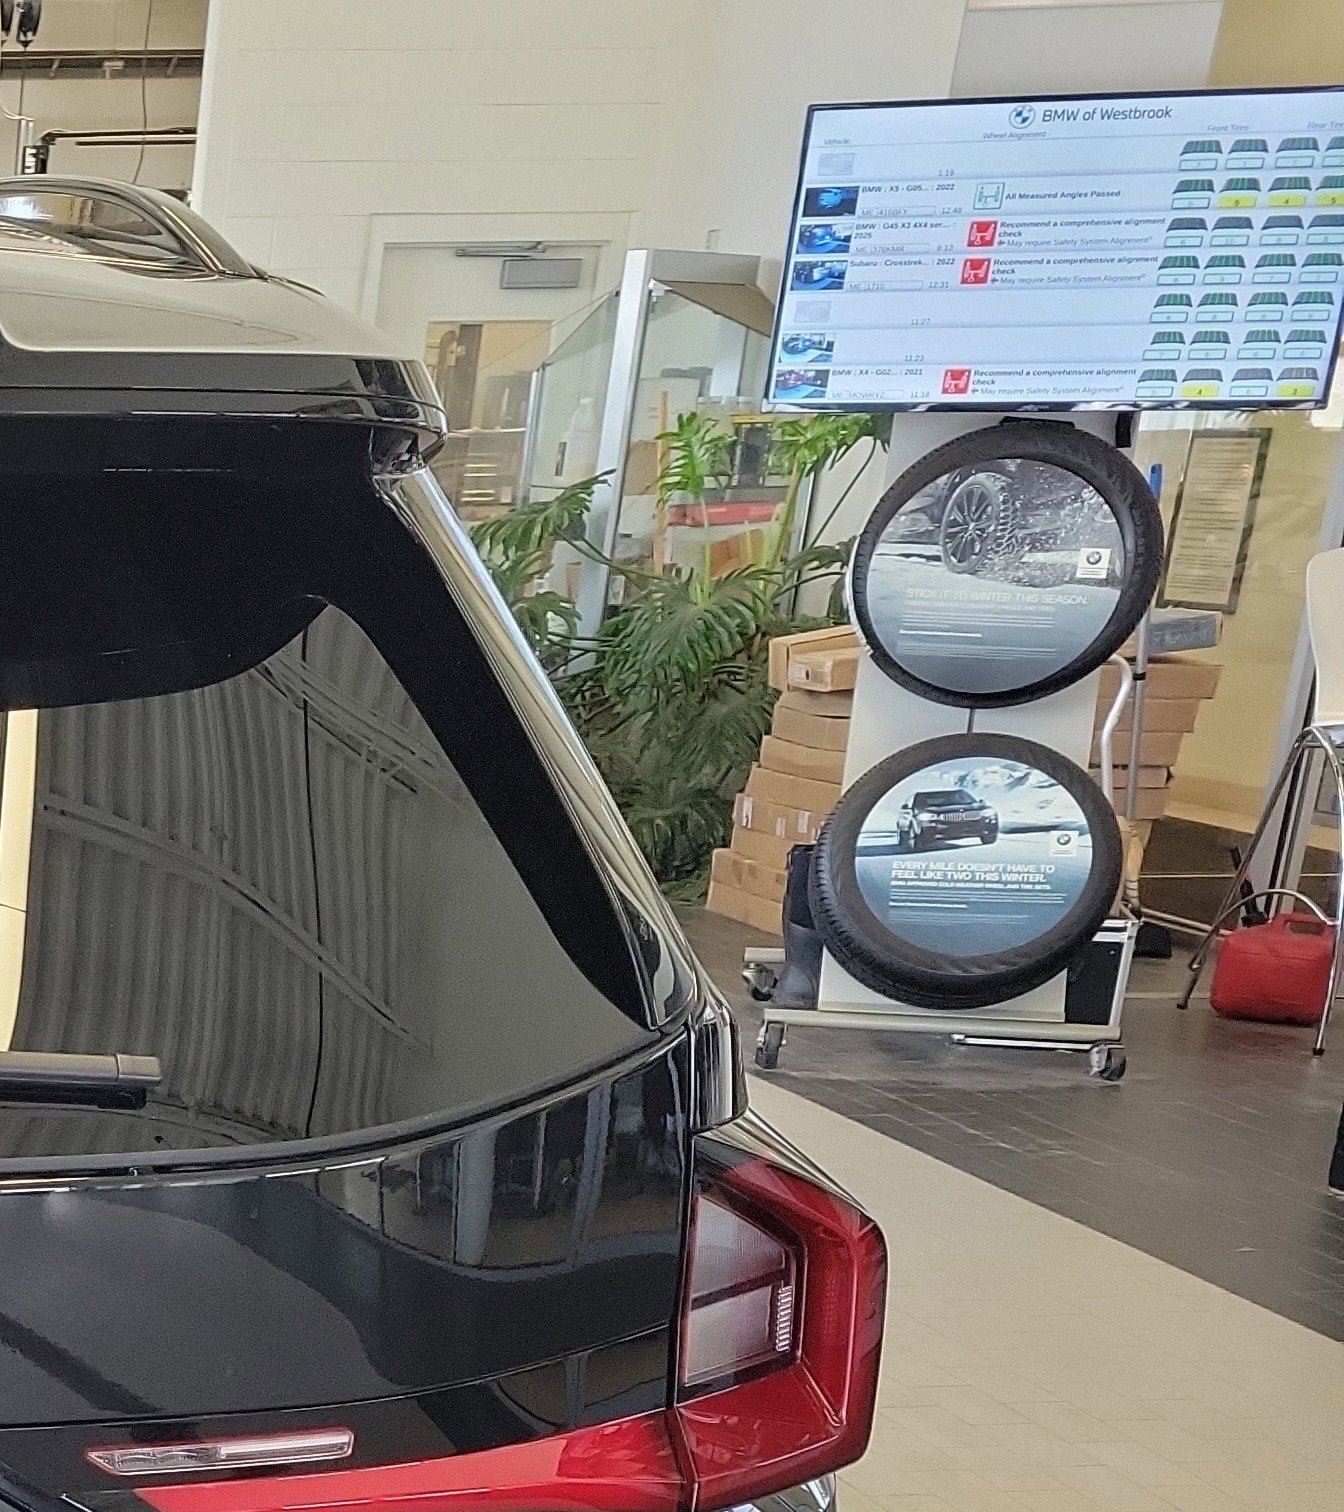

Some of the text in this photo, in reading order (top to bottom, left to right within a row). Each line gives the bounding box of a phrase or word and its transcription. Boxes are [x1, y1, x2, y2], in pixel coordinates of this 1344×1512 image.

[1042, 106, 1173, 123] BMW of Westbrook
[1009, 131, 1047, 140] Alignment
[1005, 190, 1121, 200] All Measured Angles Passed
[1059, 219, 1122, 228] comprehensive
[1124, 217, 1166, 226] alignment
[1025, 239, 1052, 247] require
[1053, 238, 1078, 246] Safety
[1080, 237, 1109, 245] System
[993, 258, 1044, 266] Recommend
[1052, 256, 1115, 265] comprehensive
[1117, 255, 1159, 264] alignment
[1018, 276, 1045, 284] require
[1046, 275, 1071, 283] Safety
[1073, 274, 1102, 283] System
[973, 369, 1024, 377] Recommend
[1032, 368, 1094, 377] comprehensive
[1096, 367, 1137, 376] alignment
[998, 387, 1024, 395] require
[1026, 387, 1050, 395] Safety
[1052, 387, 1080, 395] System
[954, 590, 969, 600] TO
[971, 591, 1011, 602] WINTER
[1015, 593, 1039, 603] THIS
[1042, 594, 1089, 605] SEASON.
[892, 860, 1055, 874] EVERY MILE DOESN'T HAVE TO
[892, 870, 1046, 883] FEEL LIKE TWO THIS WINTER.
